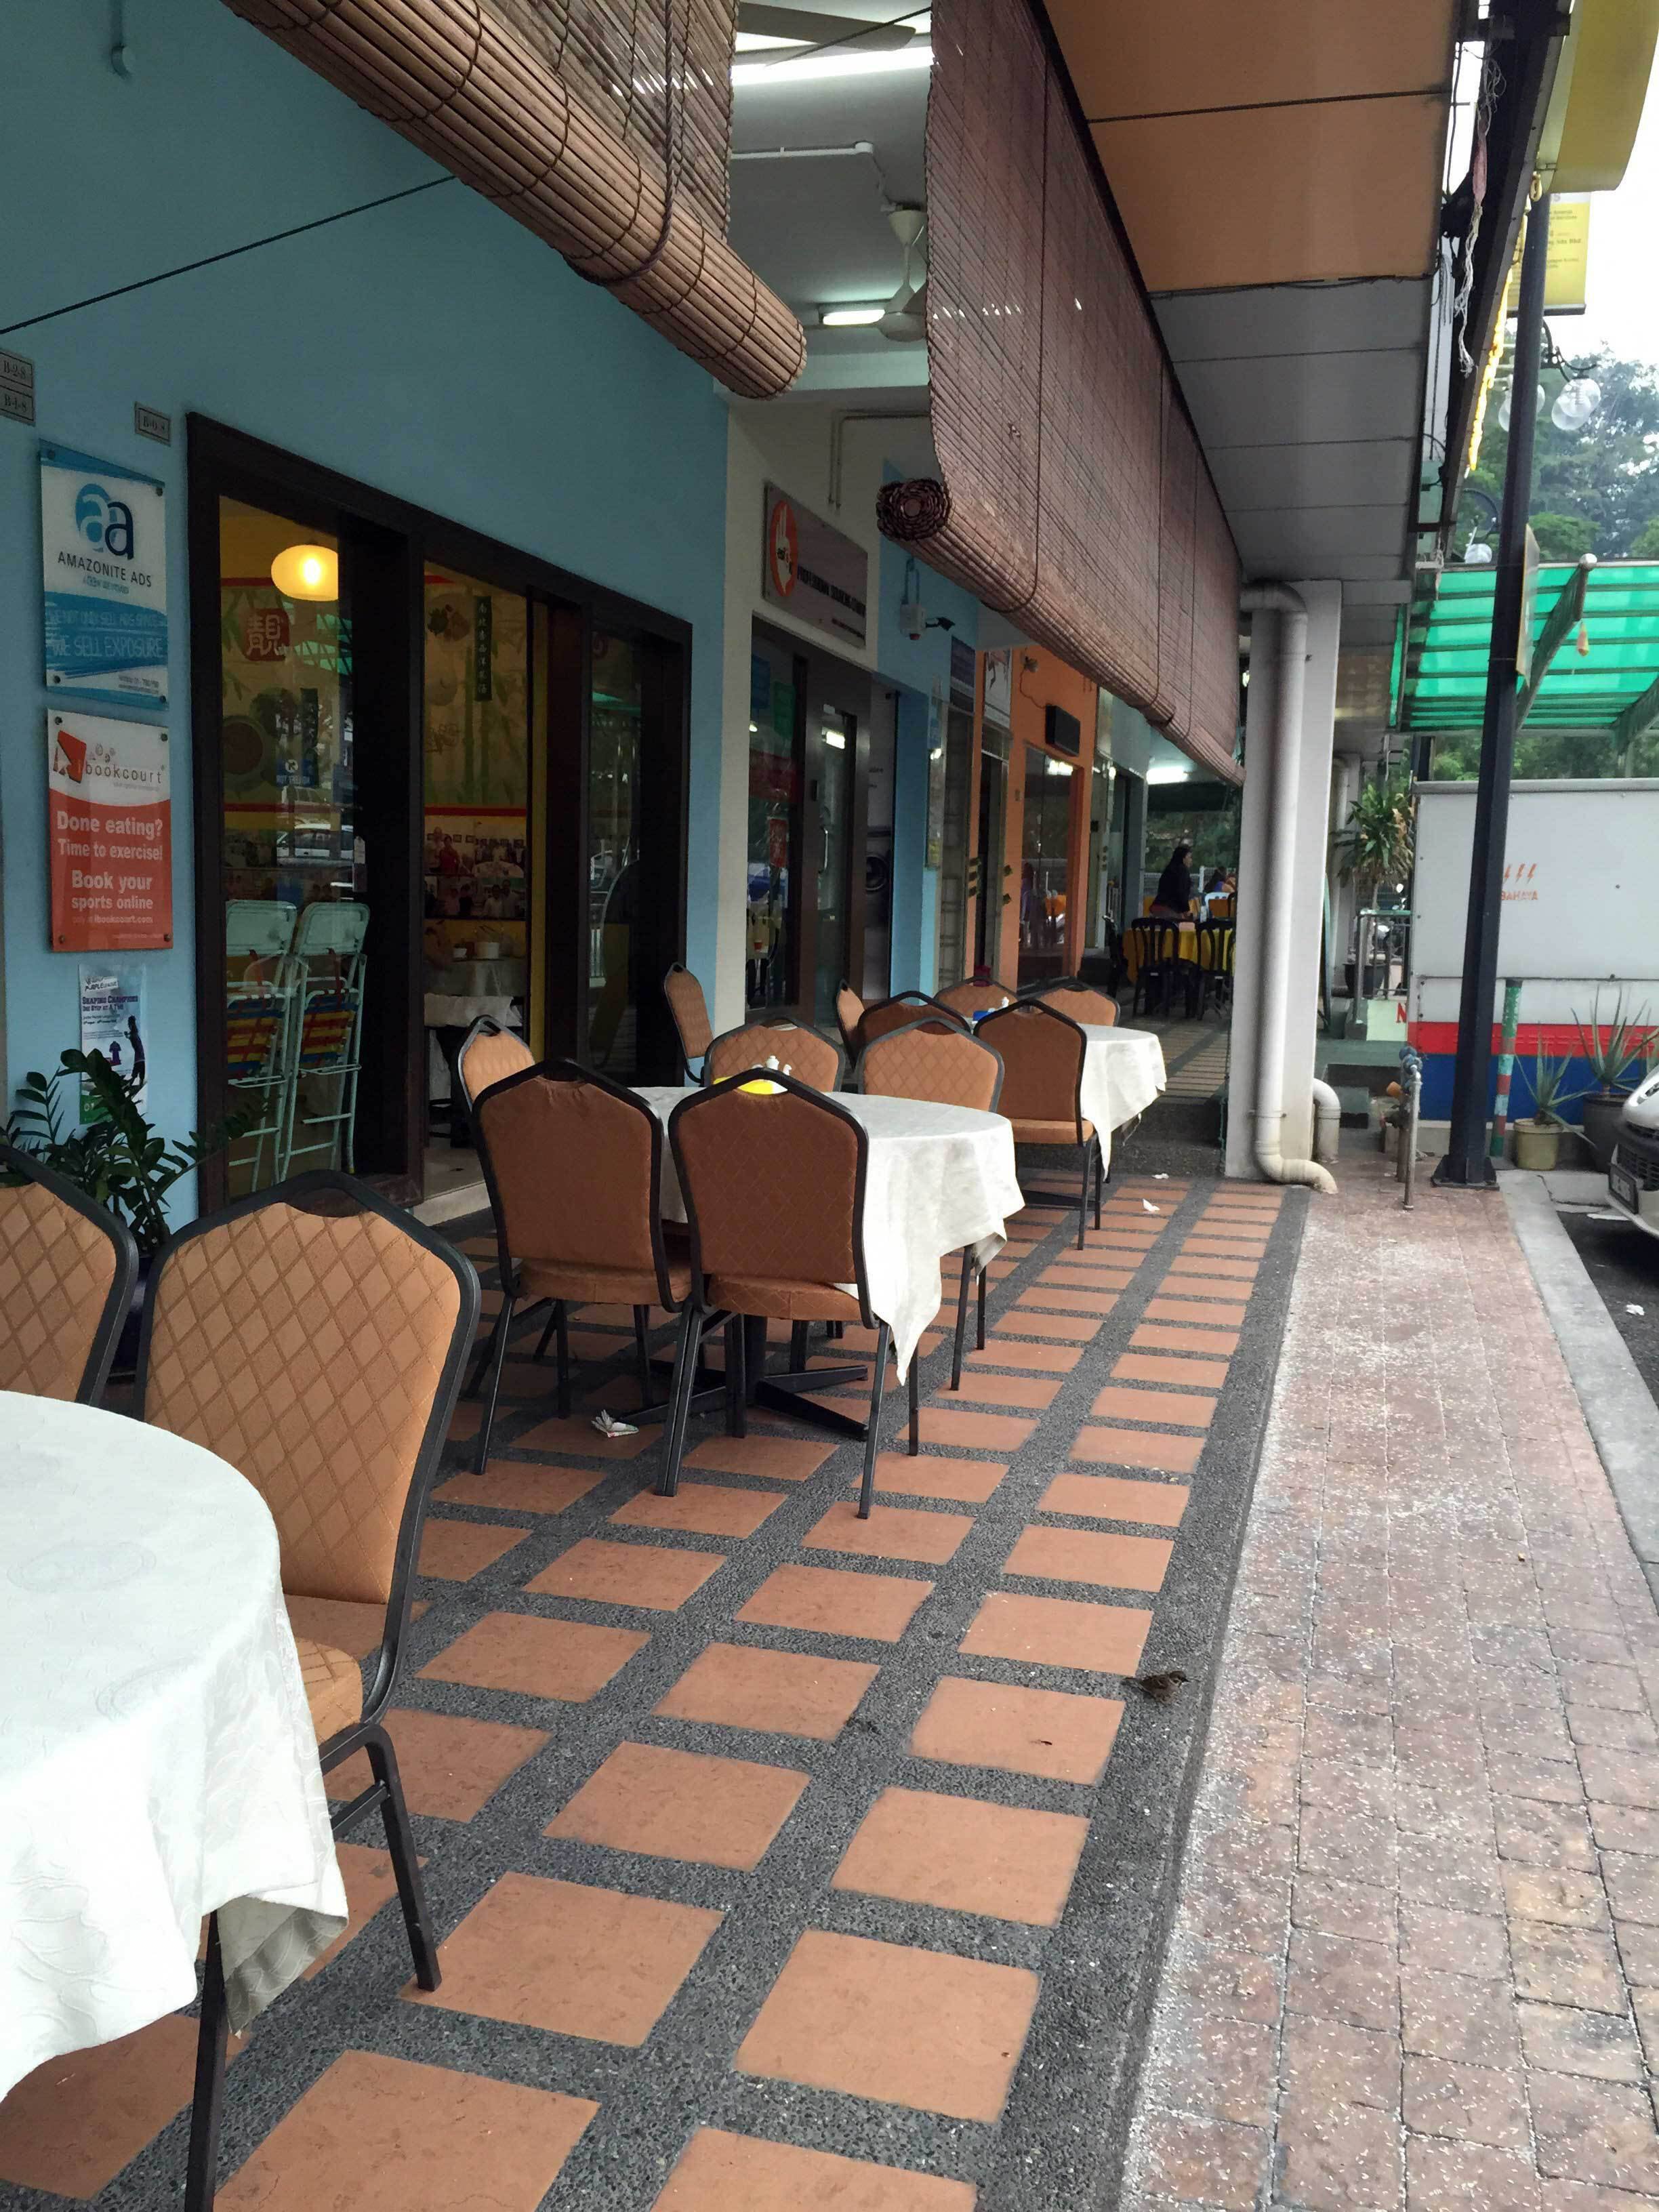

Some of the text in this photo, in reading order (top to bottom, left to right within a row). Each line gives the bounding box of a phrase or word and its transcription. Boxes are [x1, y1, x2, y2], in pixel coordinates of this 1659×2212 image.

[58, 551, 152, 588] AMAZONITE ADS
[74, 635, 102, 657] SELL
[104, 636, 164, 659] EXPOSURE
[57, 810, 163, 841] Done eating?
[58, 838, 163, 862] Time to exercise!
[72, 869, 153, 894] Book your
[71, 895, 154, 912] sports online
